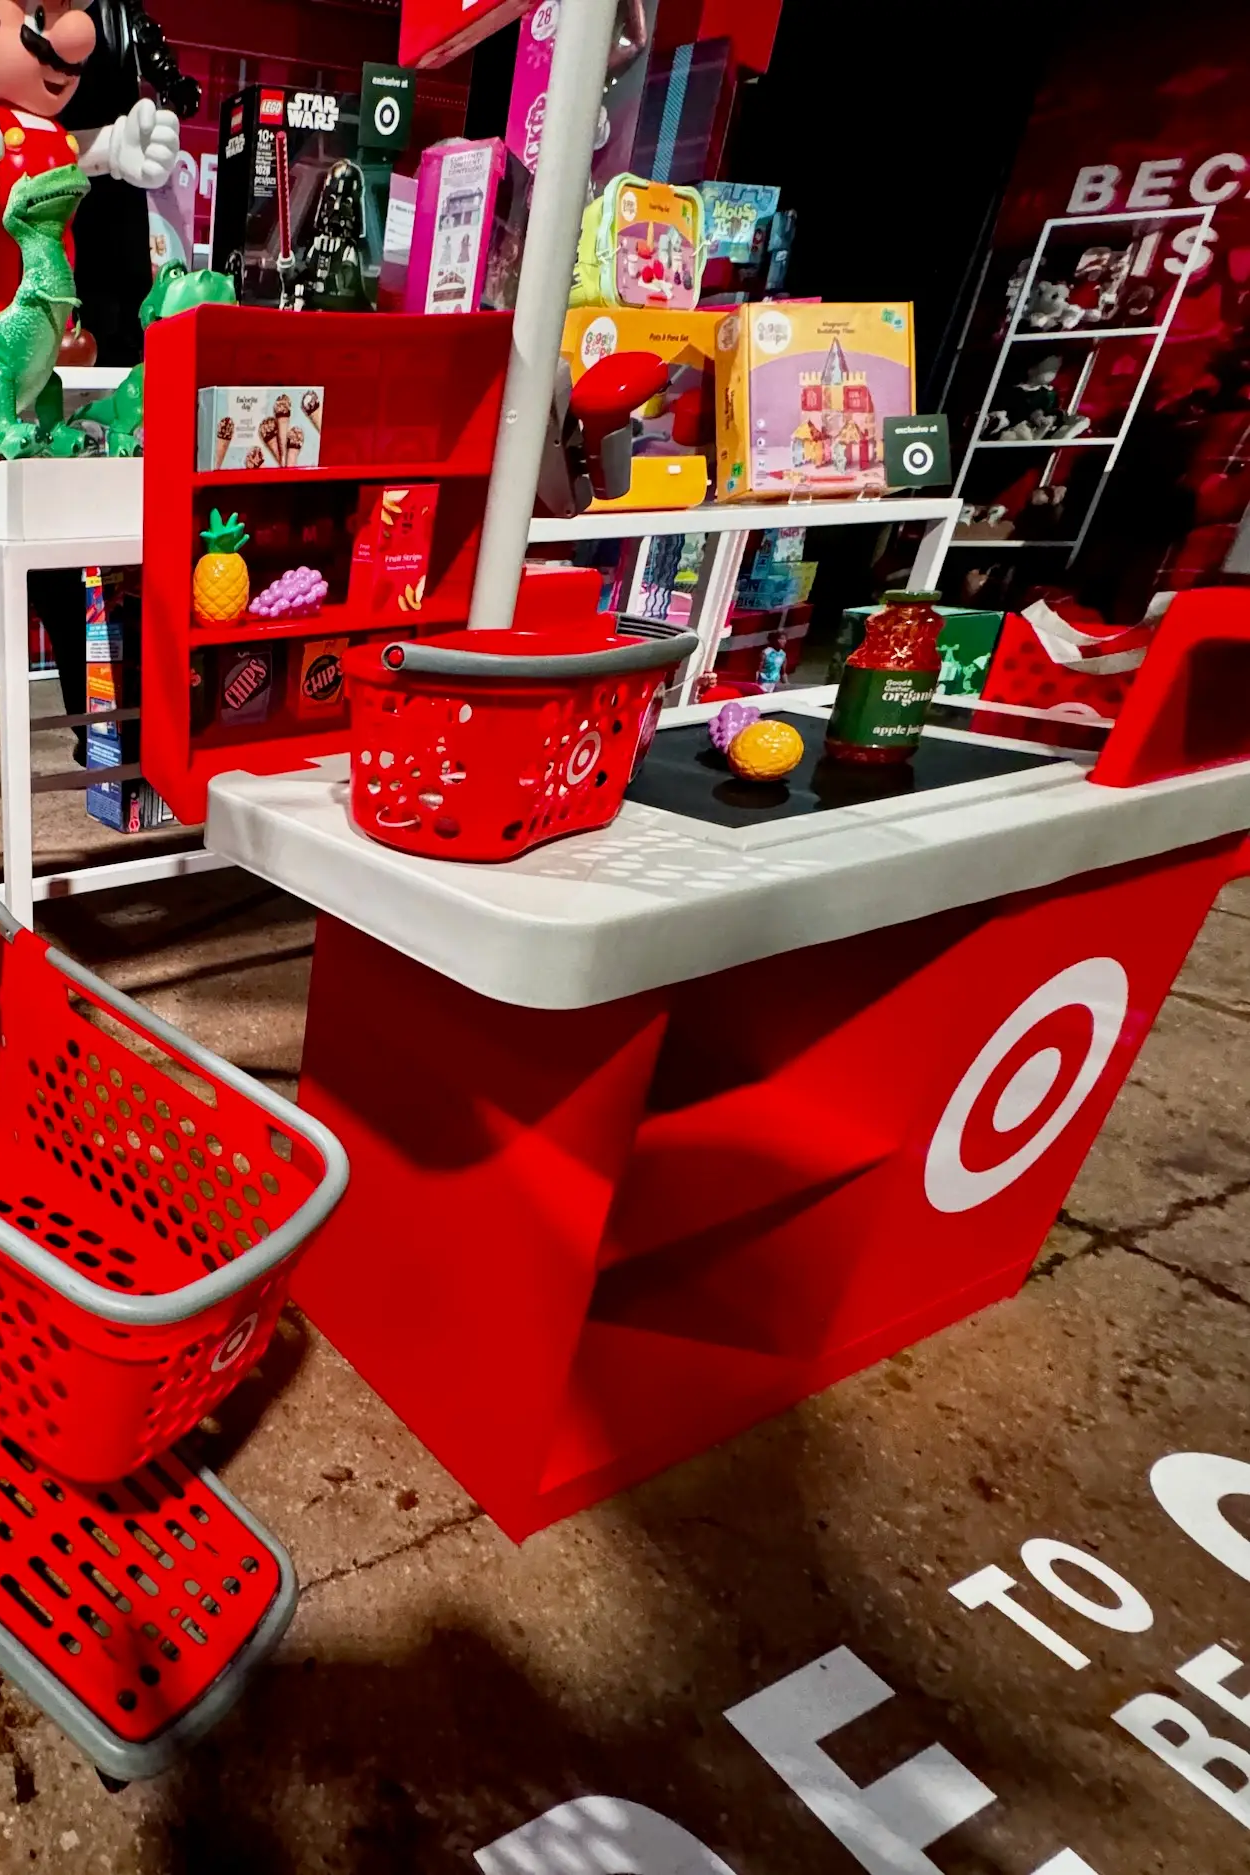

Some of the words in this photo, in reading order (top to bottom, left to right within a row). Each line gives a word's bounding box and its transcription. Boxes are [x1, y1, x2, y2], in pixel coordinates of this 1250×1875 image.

[260, 100, 282, 114] LEGO
[287, 93, 339, 114] STAR
[287, 109, 338, 131] WARS
[258, 129, 275, 143] 10+
[1066, 152, 1250, 214] BEC
[1130, 225, 1220, 278] IS
[894, 426, 929, 435] exclusive
[930, 425, 939, 433] at
[224, 658, 267, 709] CHIPS
[882, 689, 934, 707] organi
[872, 725, 907, 737] apple
[948, 1538, 1154, 1671] TO
